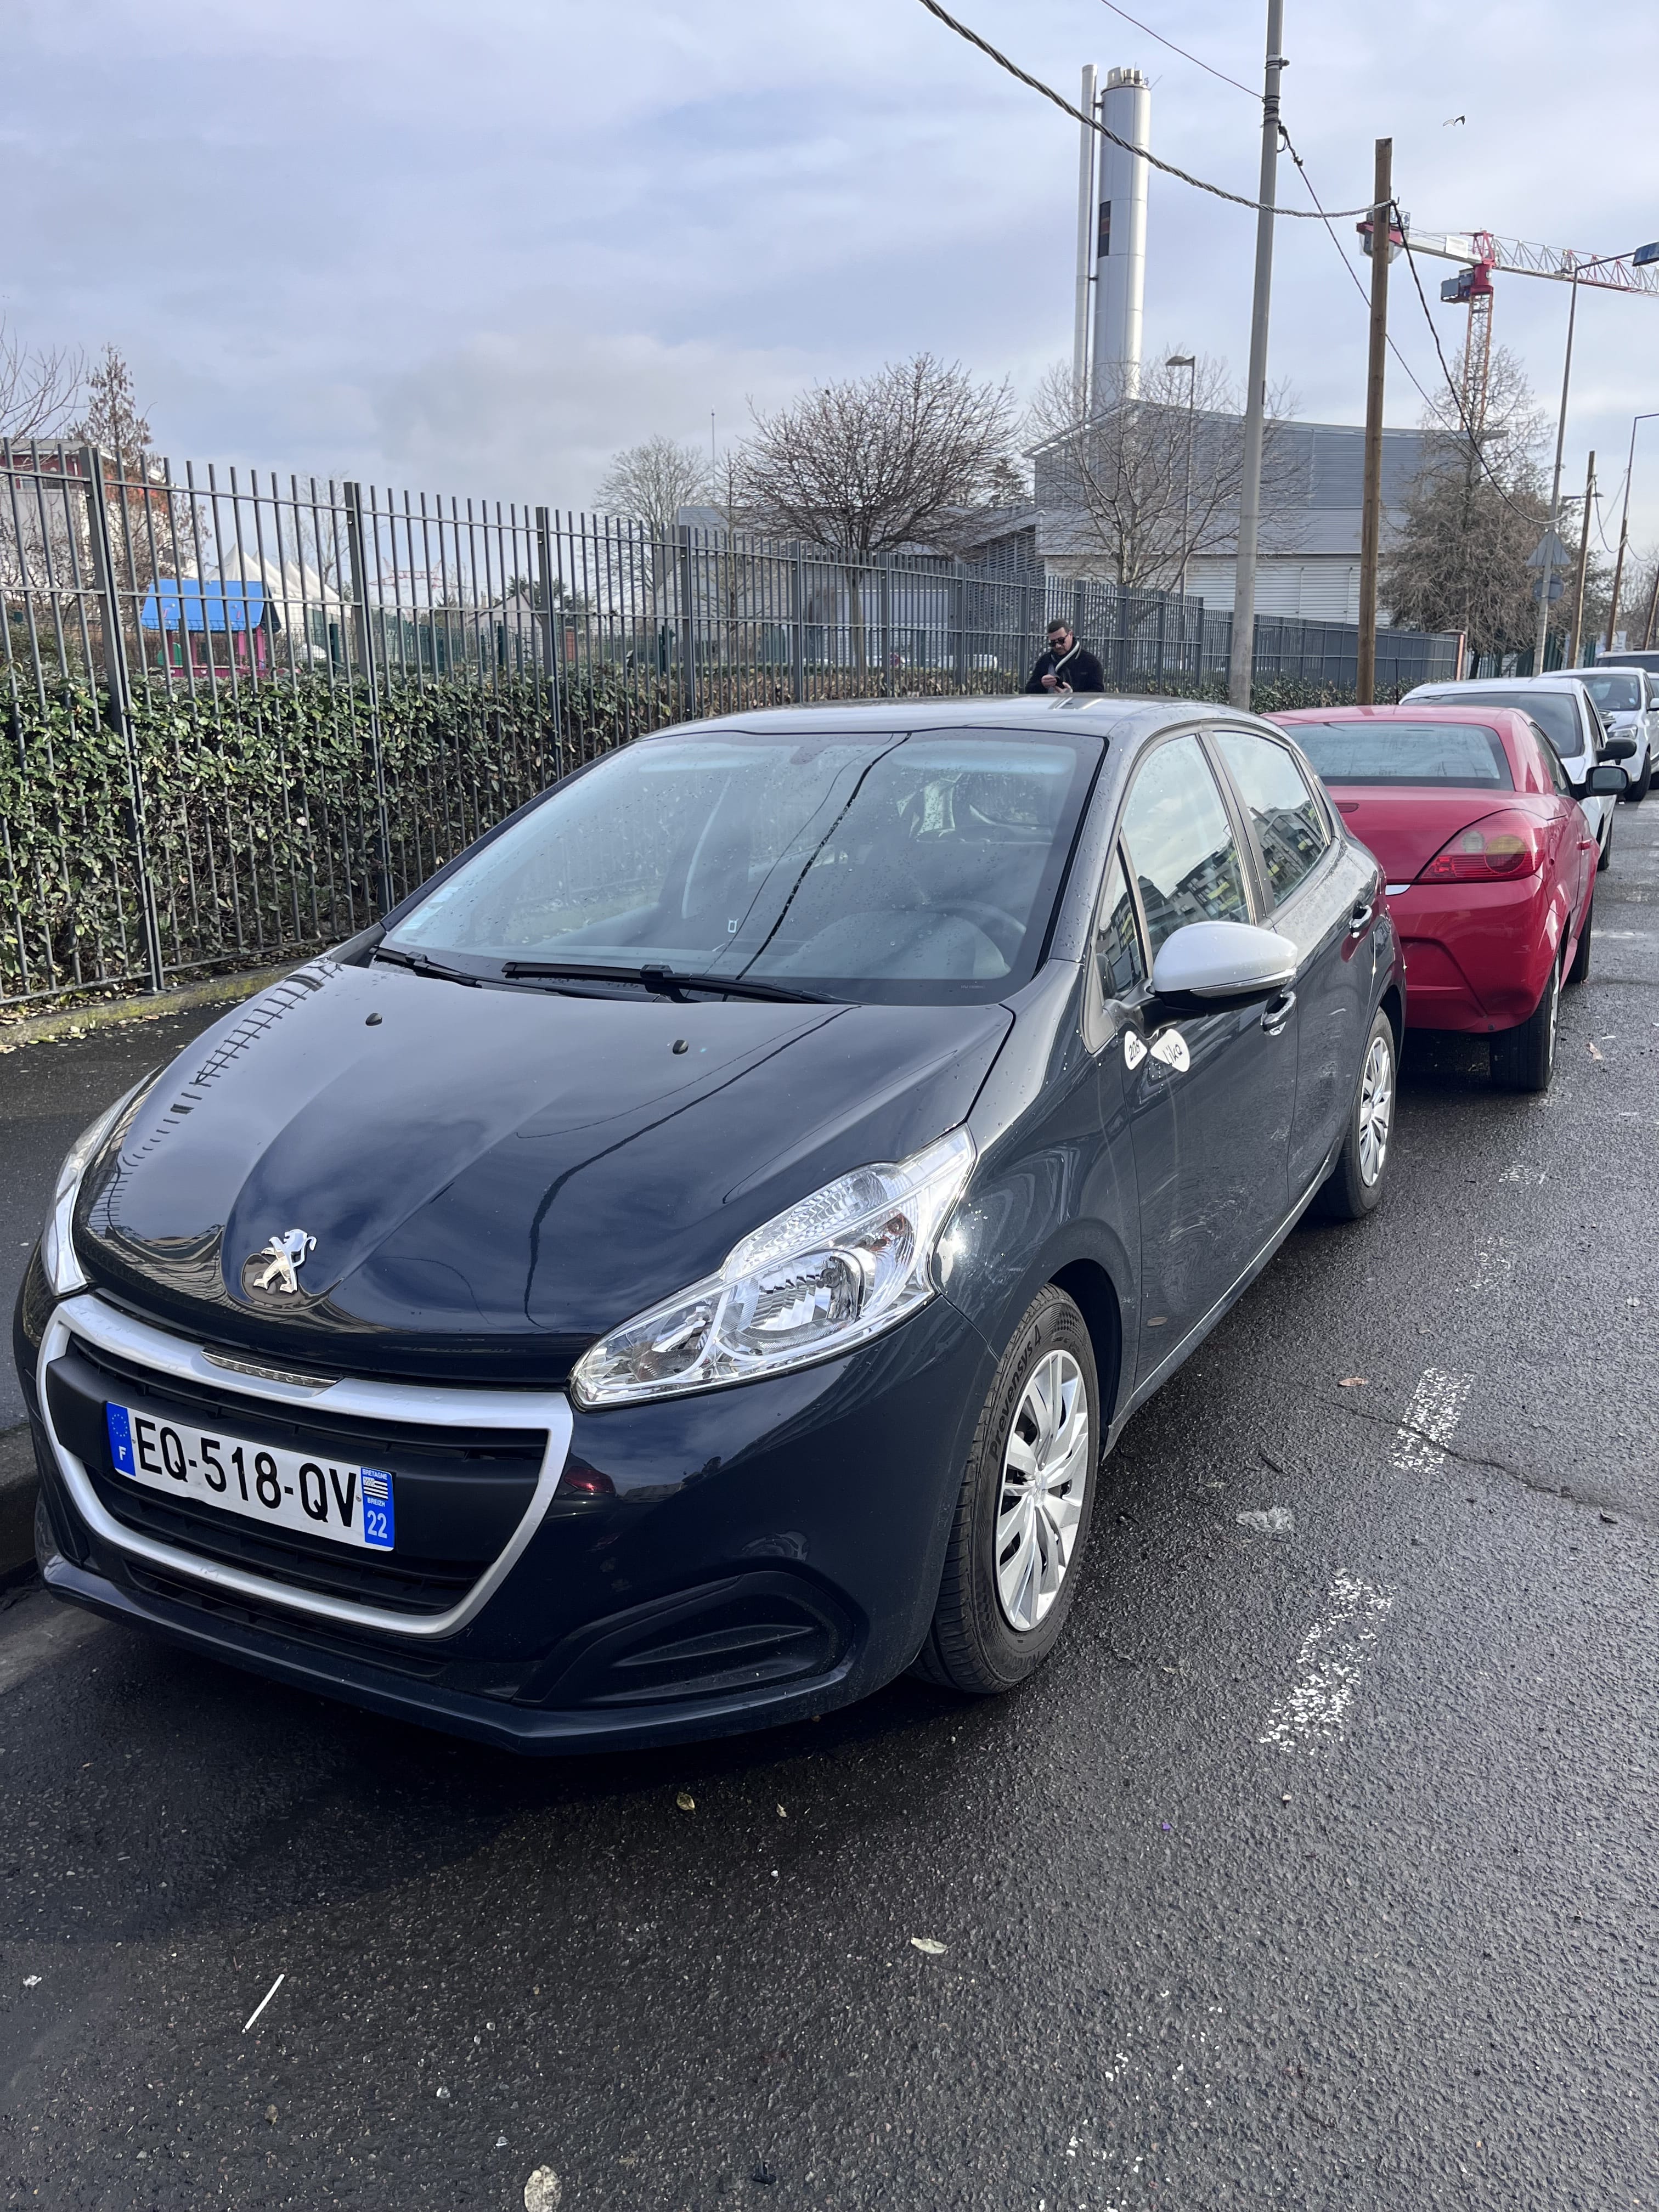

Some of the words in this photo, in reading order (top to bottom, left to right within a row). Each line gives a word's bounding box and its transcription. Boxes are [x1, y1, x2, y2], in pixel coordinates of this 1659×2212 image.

[989, 1344, 1033, 1462] Prevensys
[1035, 1324, 1041, 1346] 4
[119, 1446, 127, 1460] F
[134, 1417, 357, 1527] EQ-518-QV
[362, 1468, 388, 1480] BRETAGNE
[367, 1497, 386, 1507] BREIZH
[367, 1510, 388, 1539] 22
